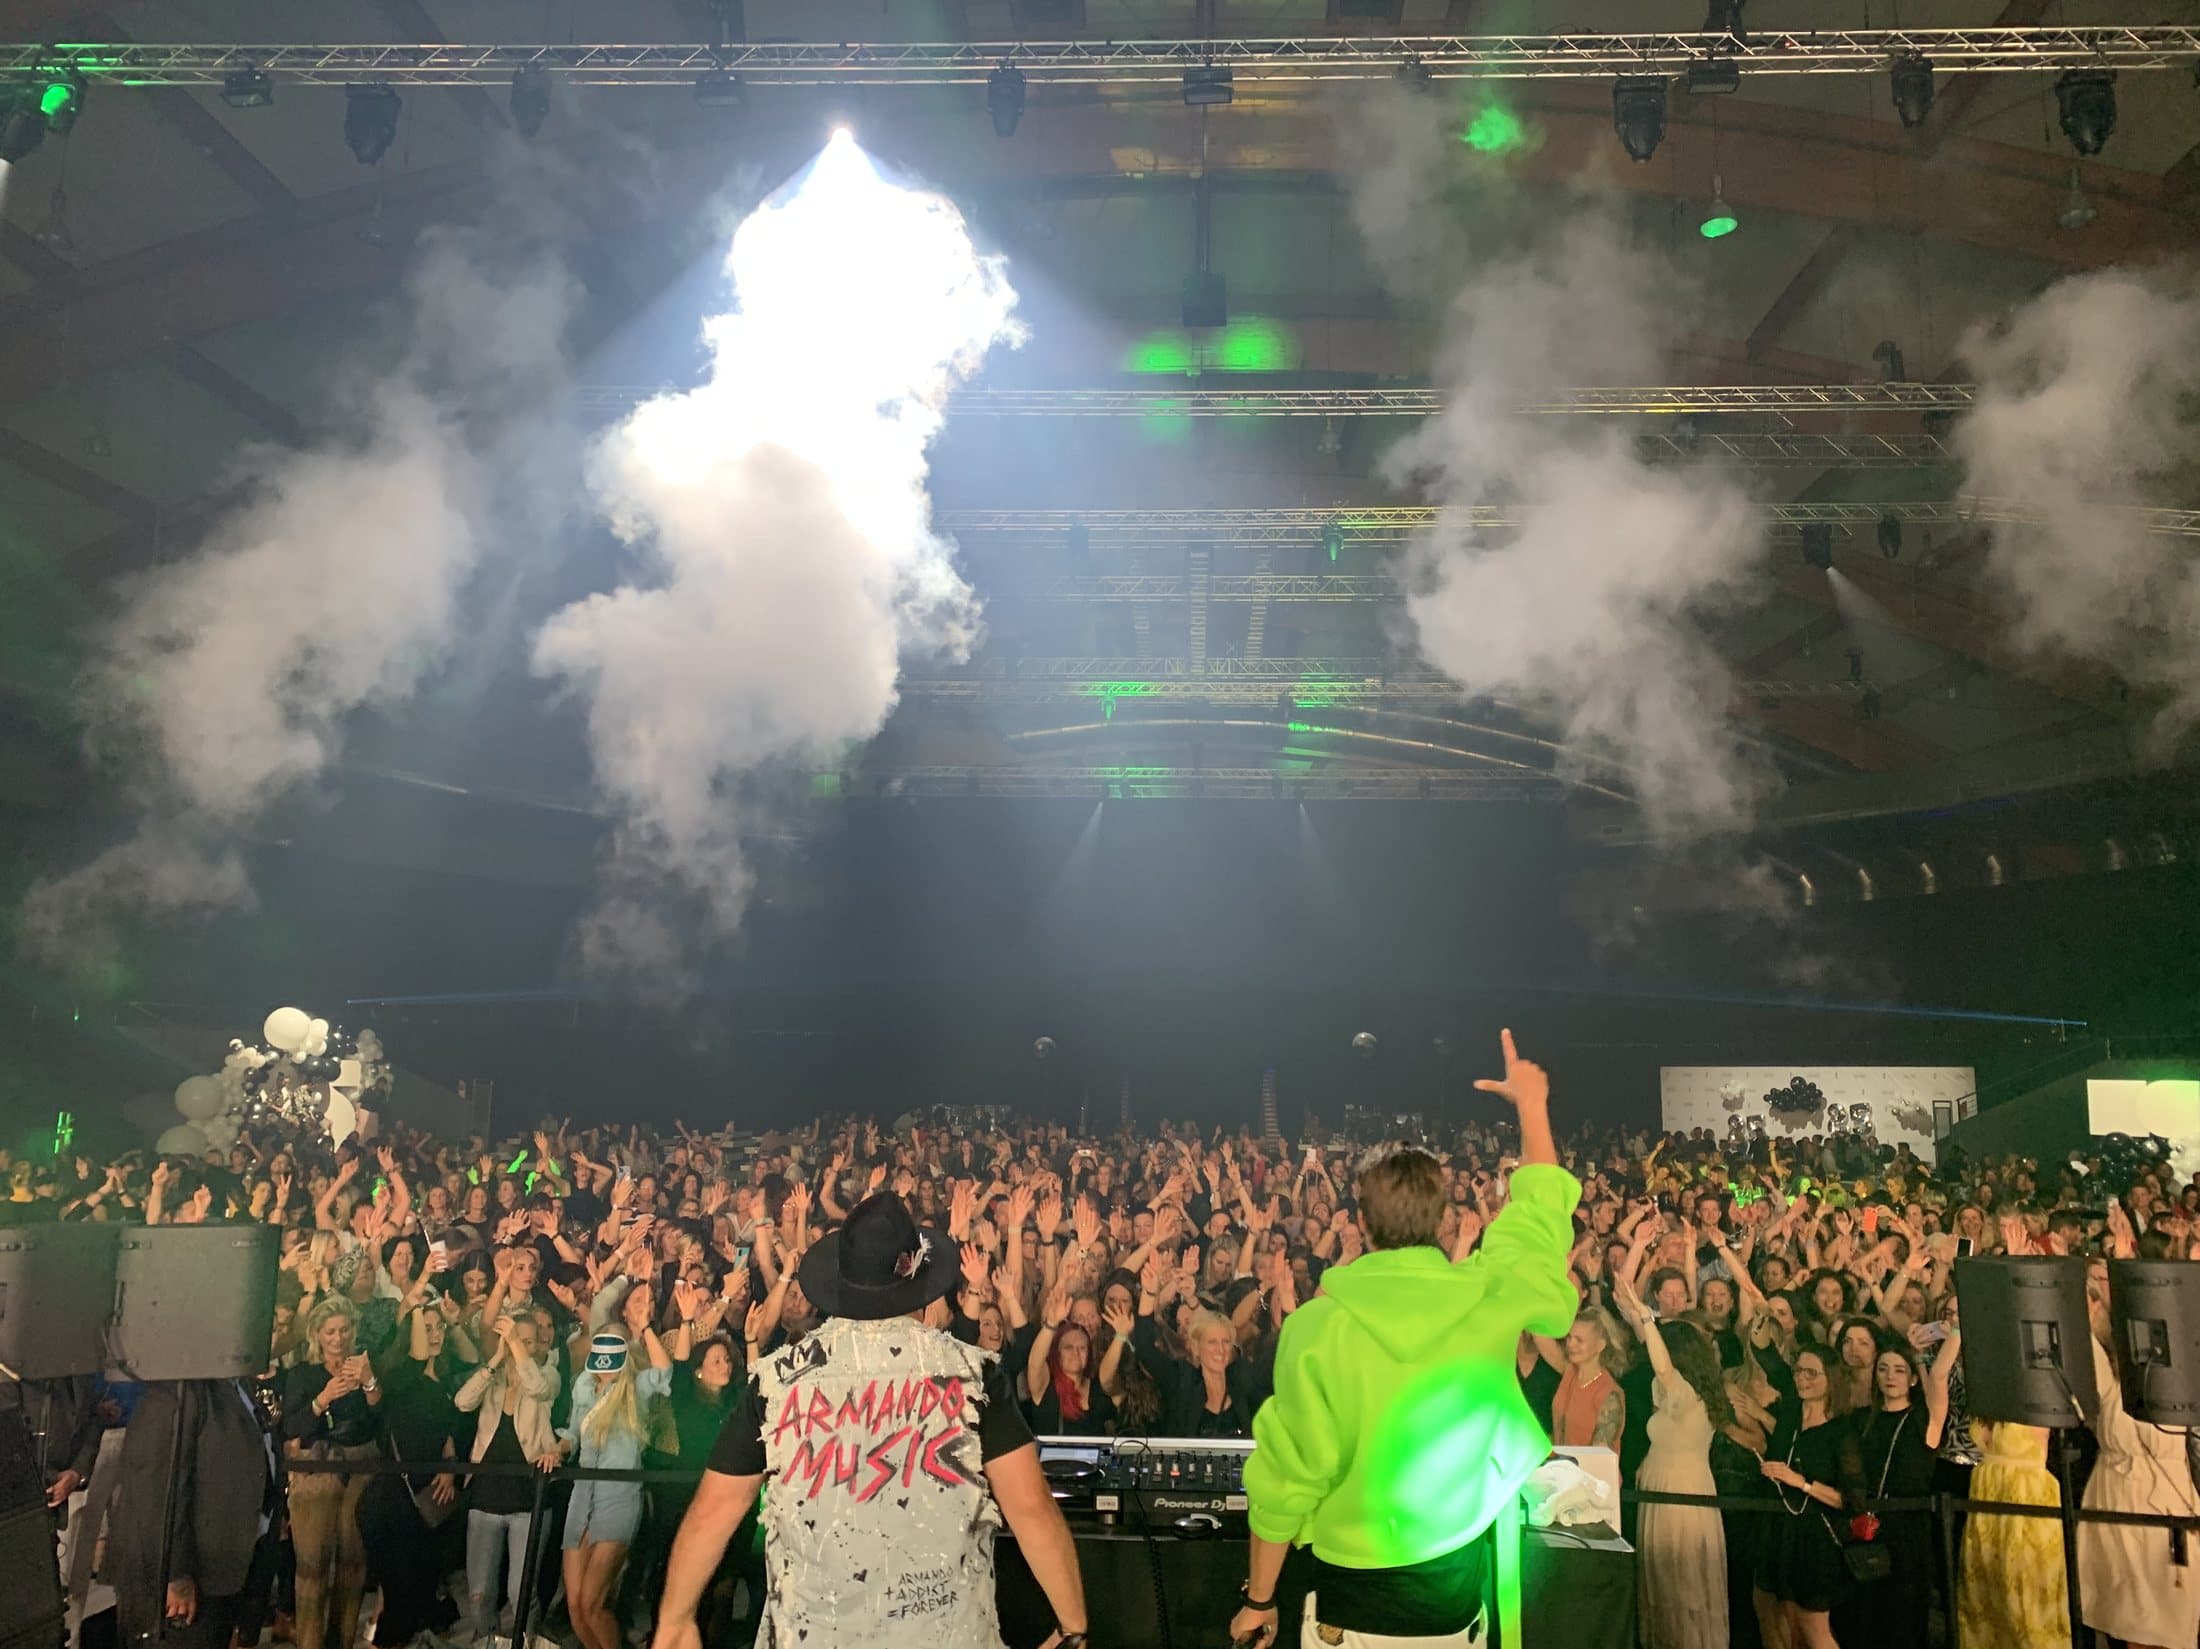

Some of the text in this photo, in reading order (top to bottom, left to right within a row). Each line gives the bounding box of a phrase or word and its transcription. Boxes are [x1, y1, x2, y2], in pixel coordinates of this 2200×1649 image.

[768, 1376, 966, 1446] ARMANDO
[781, 1425, 966, 1503] MUSIC
[1154, 1497, 1208, 1509] Pioneer
[898, 1566, 954, 1587] ARMANDO
